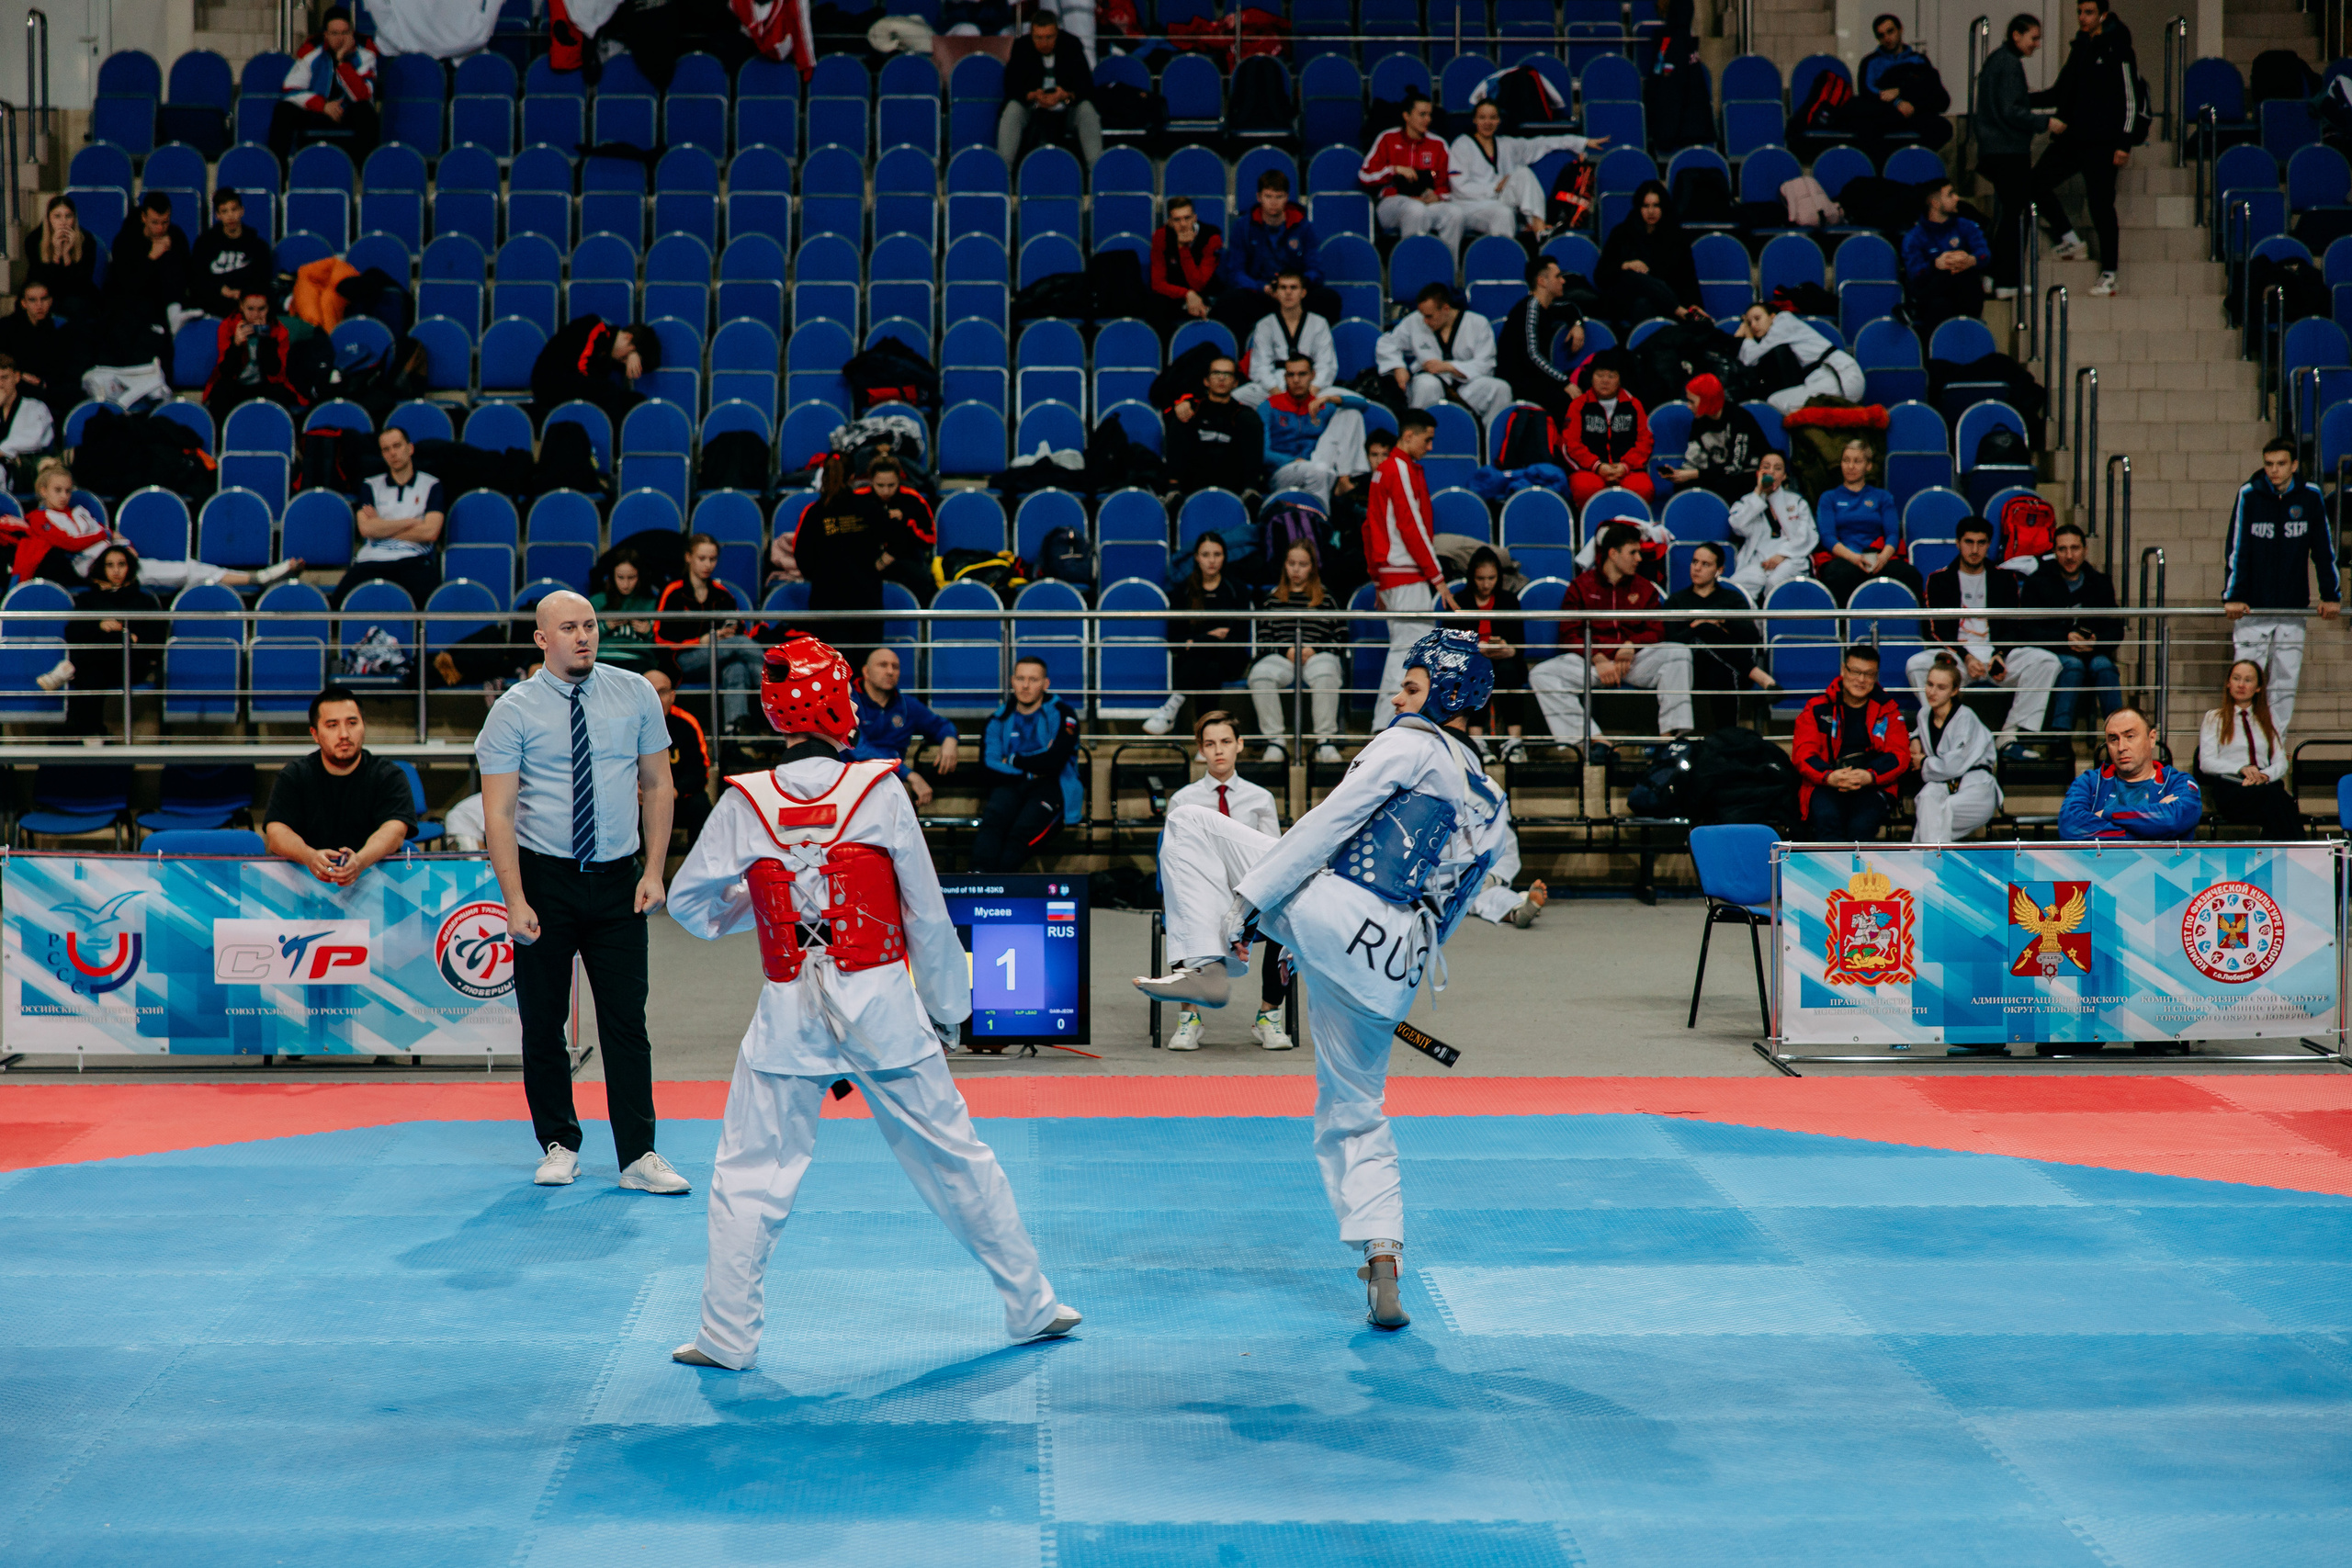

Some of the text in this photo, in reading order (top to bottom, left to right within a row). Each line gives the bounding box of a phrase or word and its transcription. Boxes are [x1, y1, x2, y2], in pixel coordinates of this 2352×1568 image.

[974, 906, 1012, 918] Мусаев
[442, 906, 479, 942] ФЕДЕРАЦИЯ
[1046, 925, 1075, 938] RUS
[2183, 883, 2283, 972] КОМИТЕТ ПО ФИЗИЧЕСКОЙ КУЛЬТУРЕ И СПОРТУ
[1345, 918, 1430, 988] RUS
[995, 947, 1016, 991] 1
[461, 981, 513, 997] ЛЮБЕРЦЫ
[224, 1007, 255, 1015] СОЮЗ
[320, 1007, 362, 1015] РОССИИ
[2003, 1005, 2041, 1014] ОКРУГА
[987, 1018, 1065, 1030] 1 0
[1397, 1022, 1432, 1049] VGENIY
